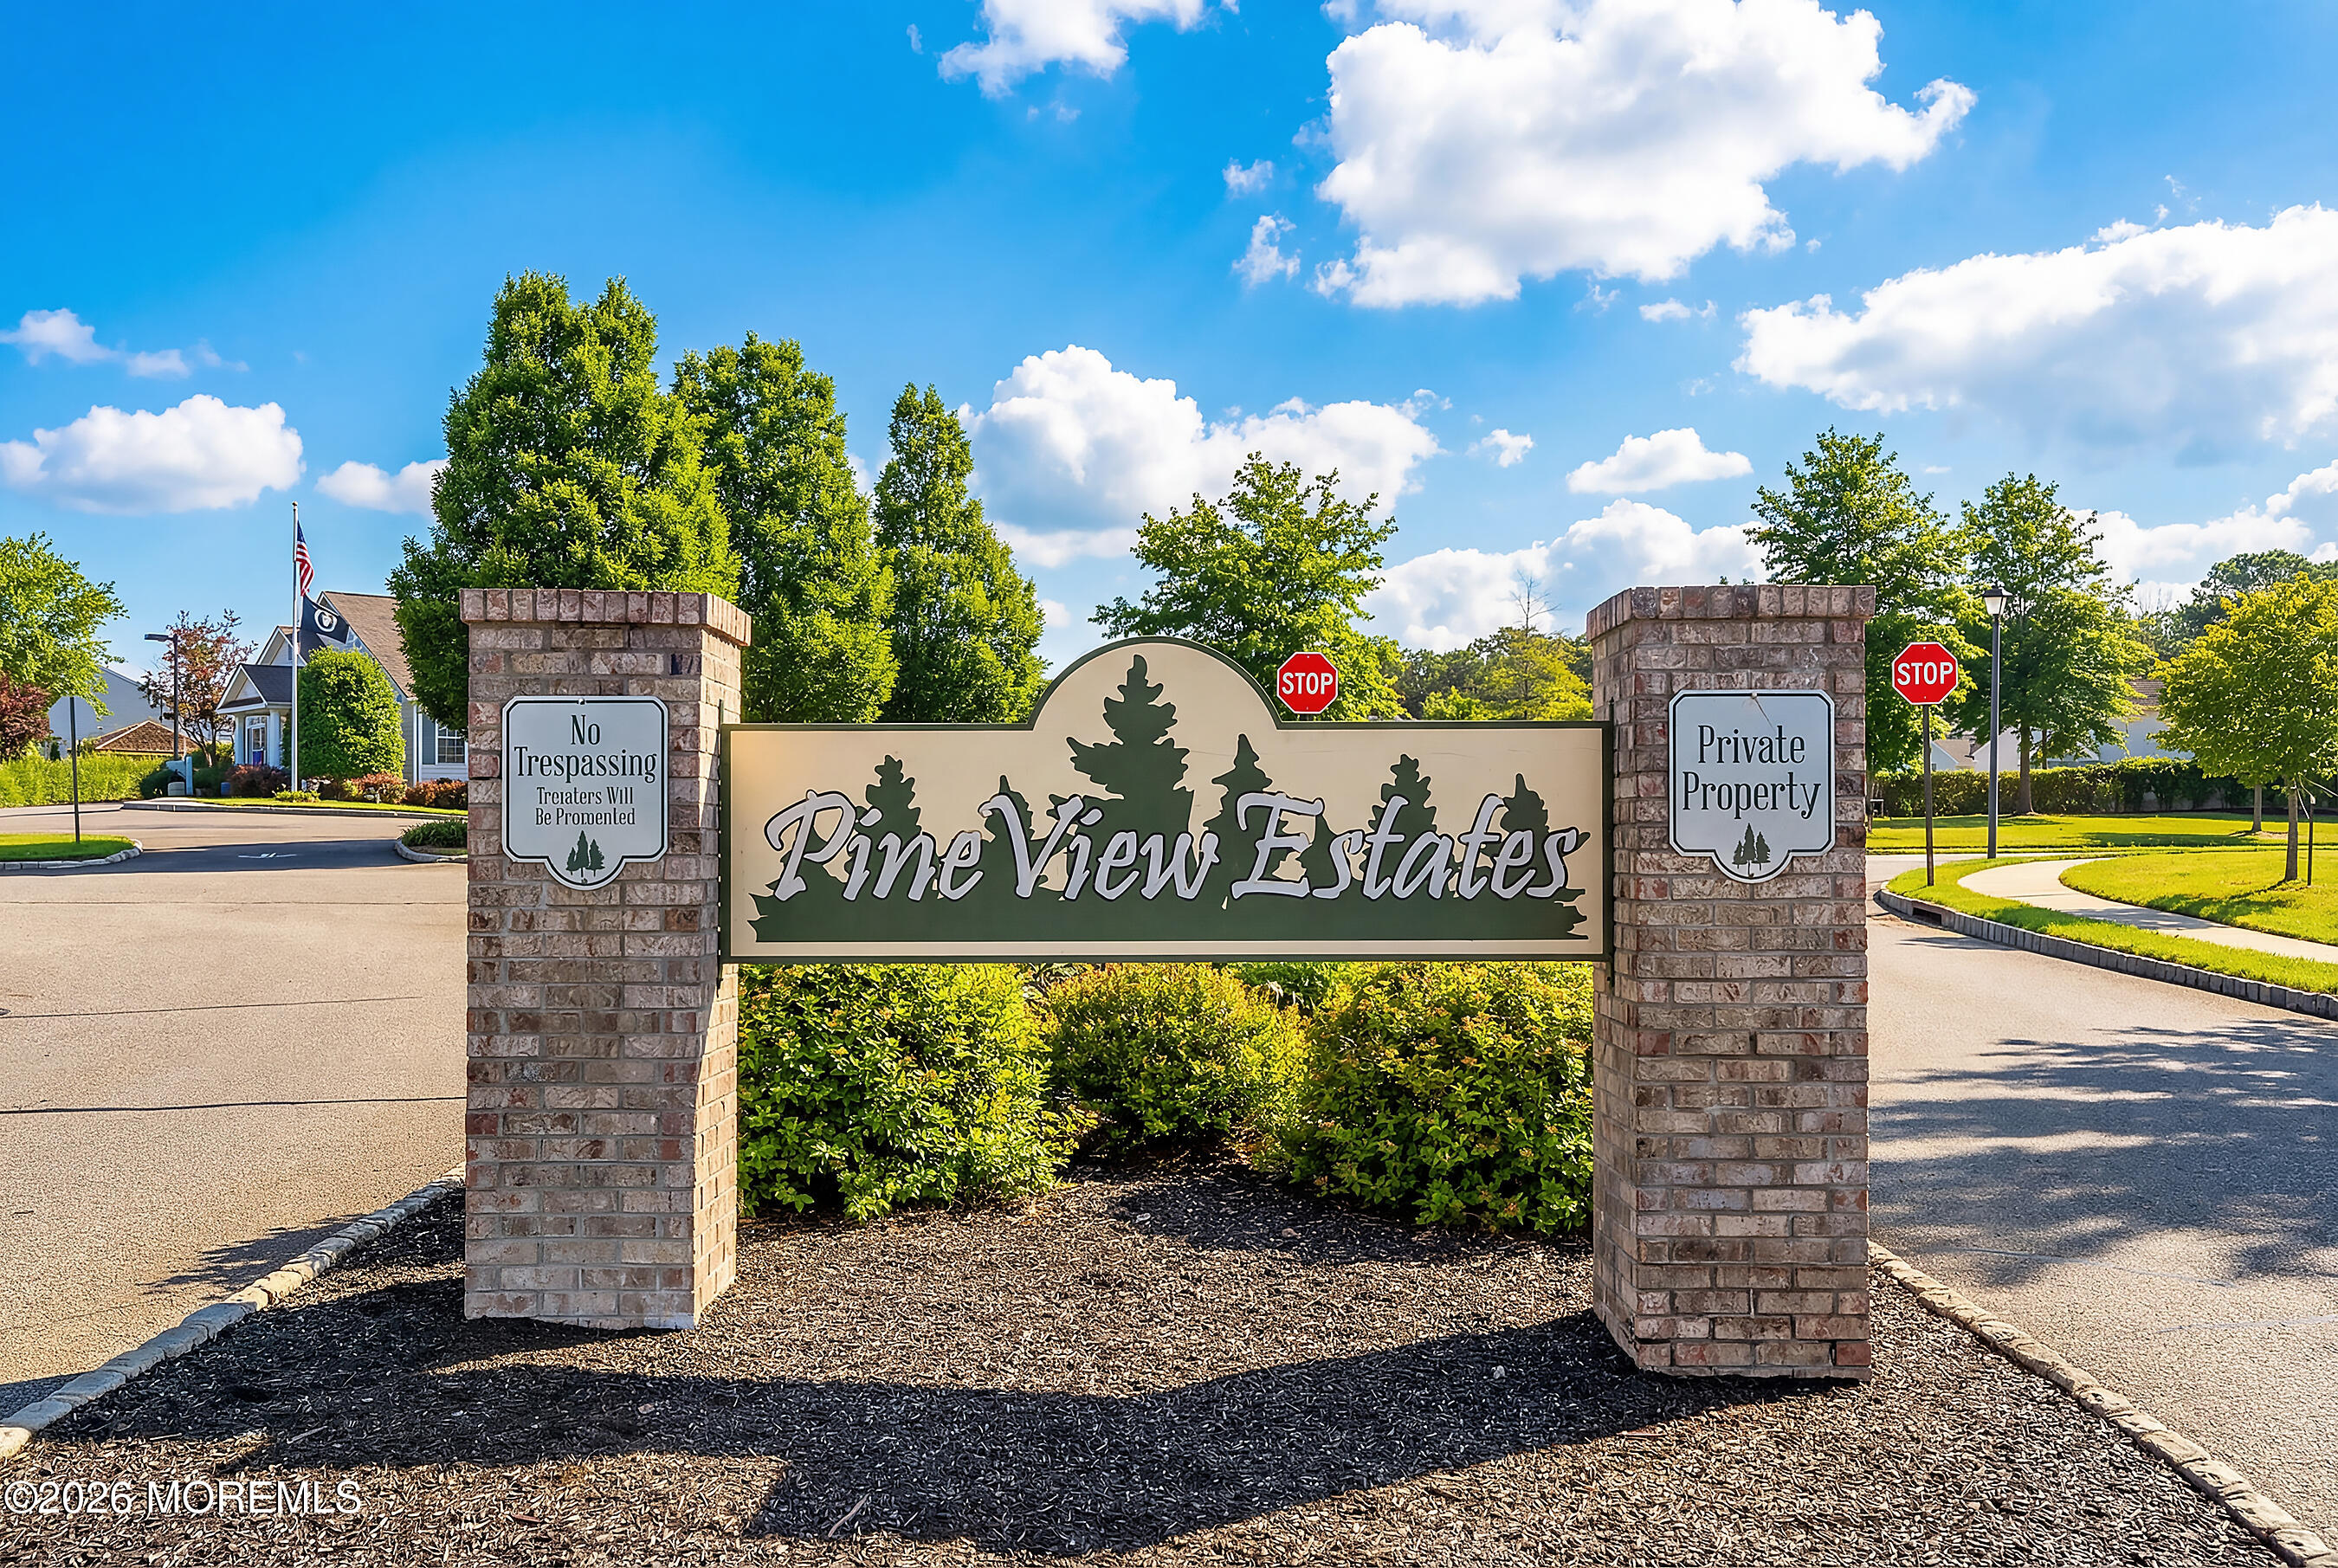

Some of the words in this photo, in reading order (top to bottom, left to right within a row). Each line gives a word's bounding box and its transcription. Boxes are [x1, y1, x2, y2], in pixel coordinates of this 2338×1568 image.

[1282, 672, 1334, 695] STOP
[1896, 661, 1954, 686] STOP
[571, 714, 601, 745] No
[1698, 725, 1805, 764] Private
[514, 746, 656, 783] Trespassing
[607, 787, 634, 804] Will
[1682, 771, 1821, 820] Property
[535, 808, 552, 825] Be
[764, 789, 985, 902] Pine
[978, 790, 1222, 900] View
[1230, 790, 1579, 900] Estates
